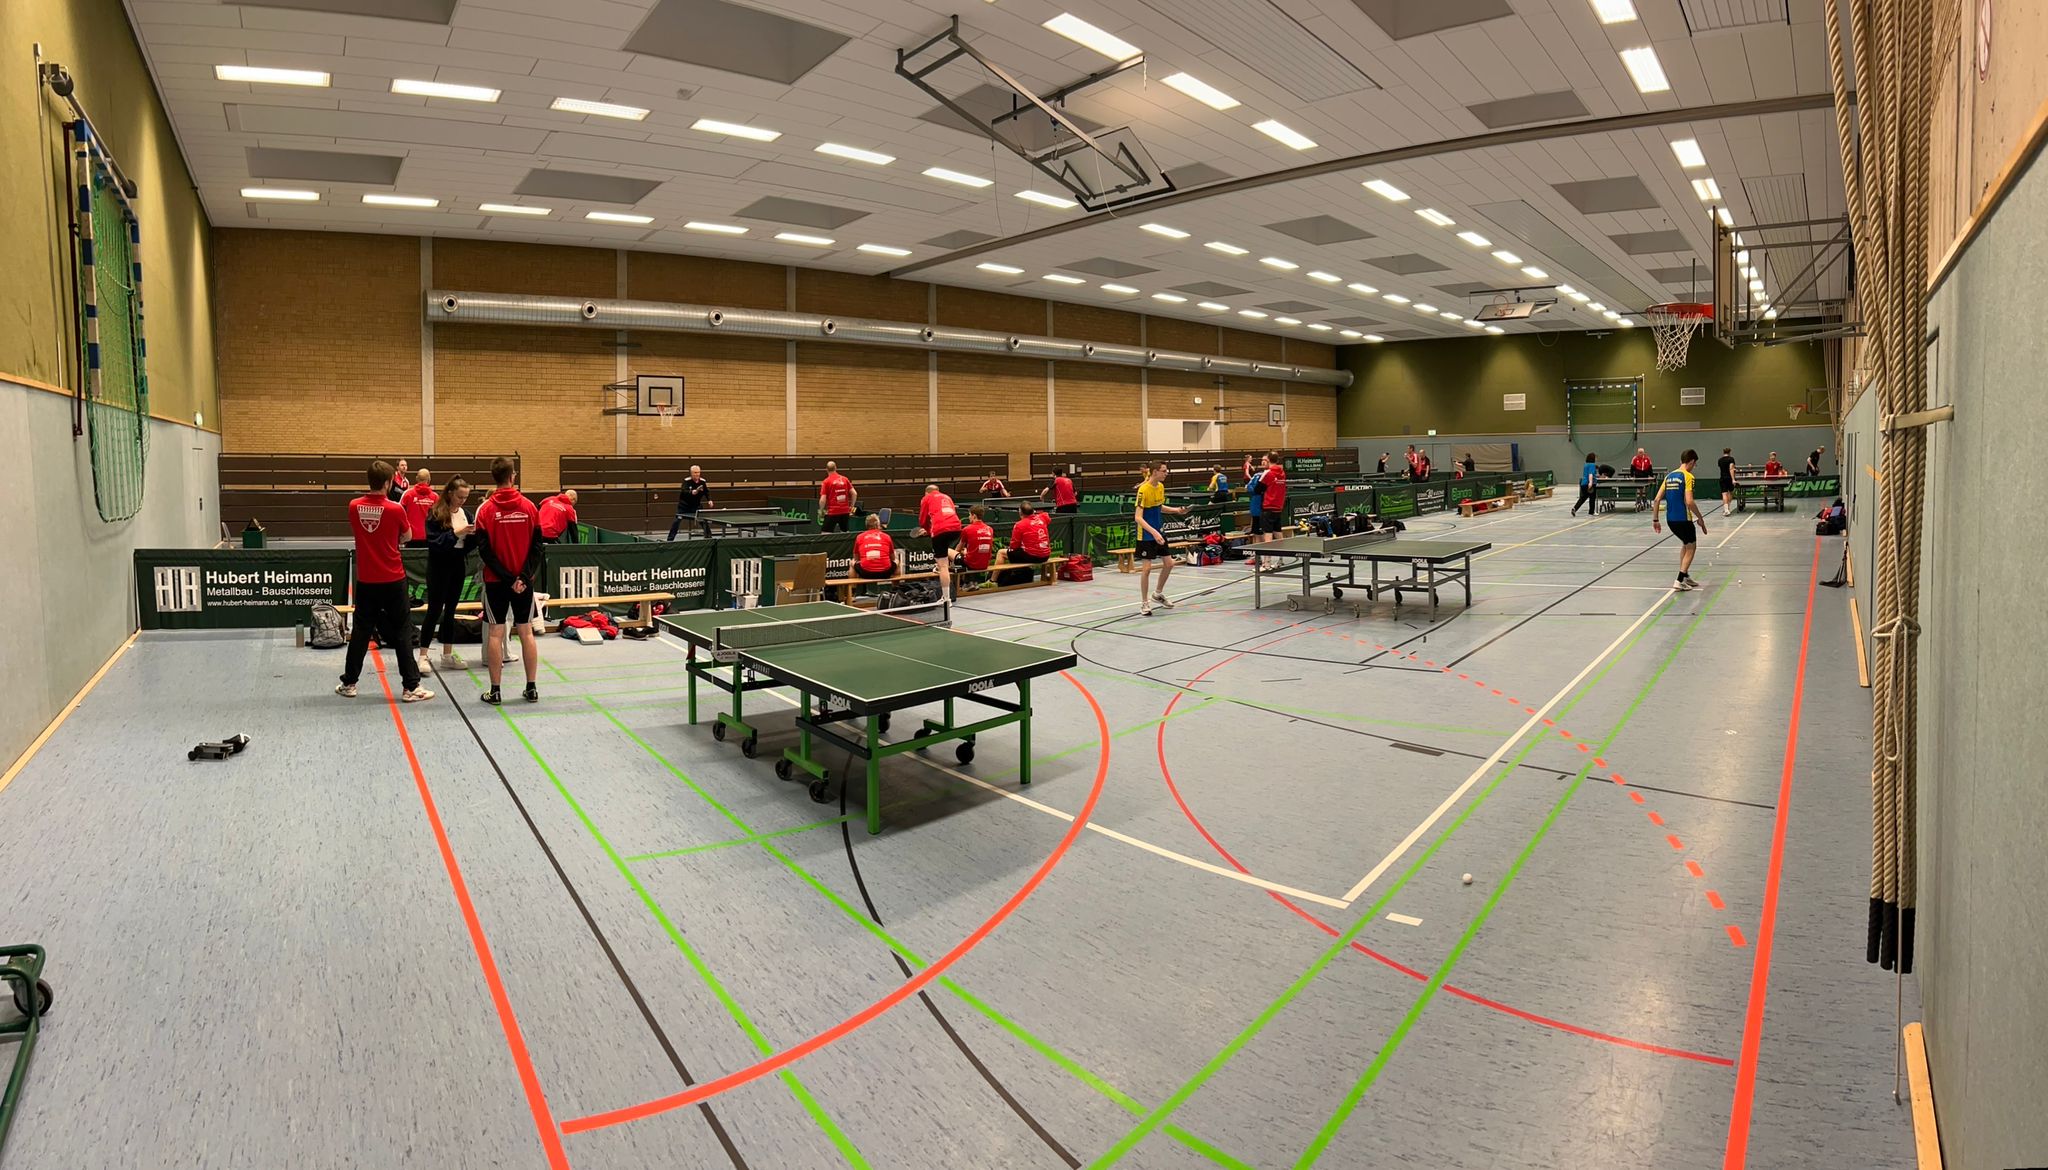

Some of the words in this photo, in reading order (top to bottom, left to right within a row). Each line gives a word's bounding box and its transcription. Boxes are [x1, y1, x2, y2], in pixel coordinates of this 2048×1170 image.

[909, 551, 934, 562] Hube
[205, 570, 260, 584] Hubert
[264, 570, 333, 584] Heimann
[603, 569, 648, 583] Hubert
[651, 567, 706, 581] Heimann
[206, 587, 253, 596] Metallbau
[262, 586, 333, 596] Bauschlosserei
[603, 584, 642, 593] Metallbau
[649, 579, 705, 591] Bauschlosserei
[206, 599, 279, 607] www.hubert-heimann.de
[967, 679, 995, 694] JOOLA
